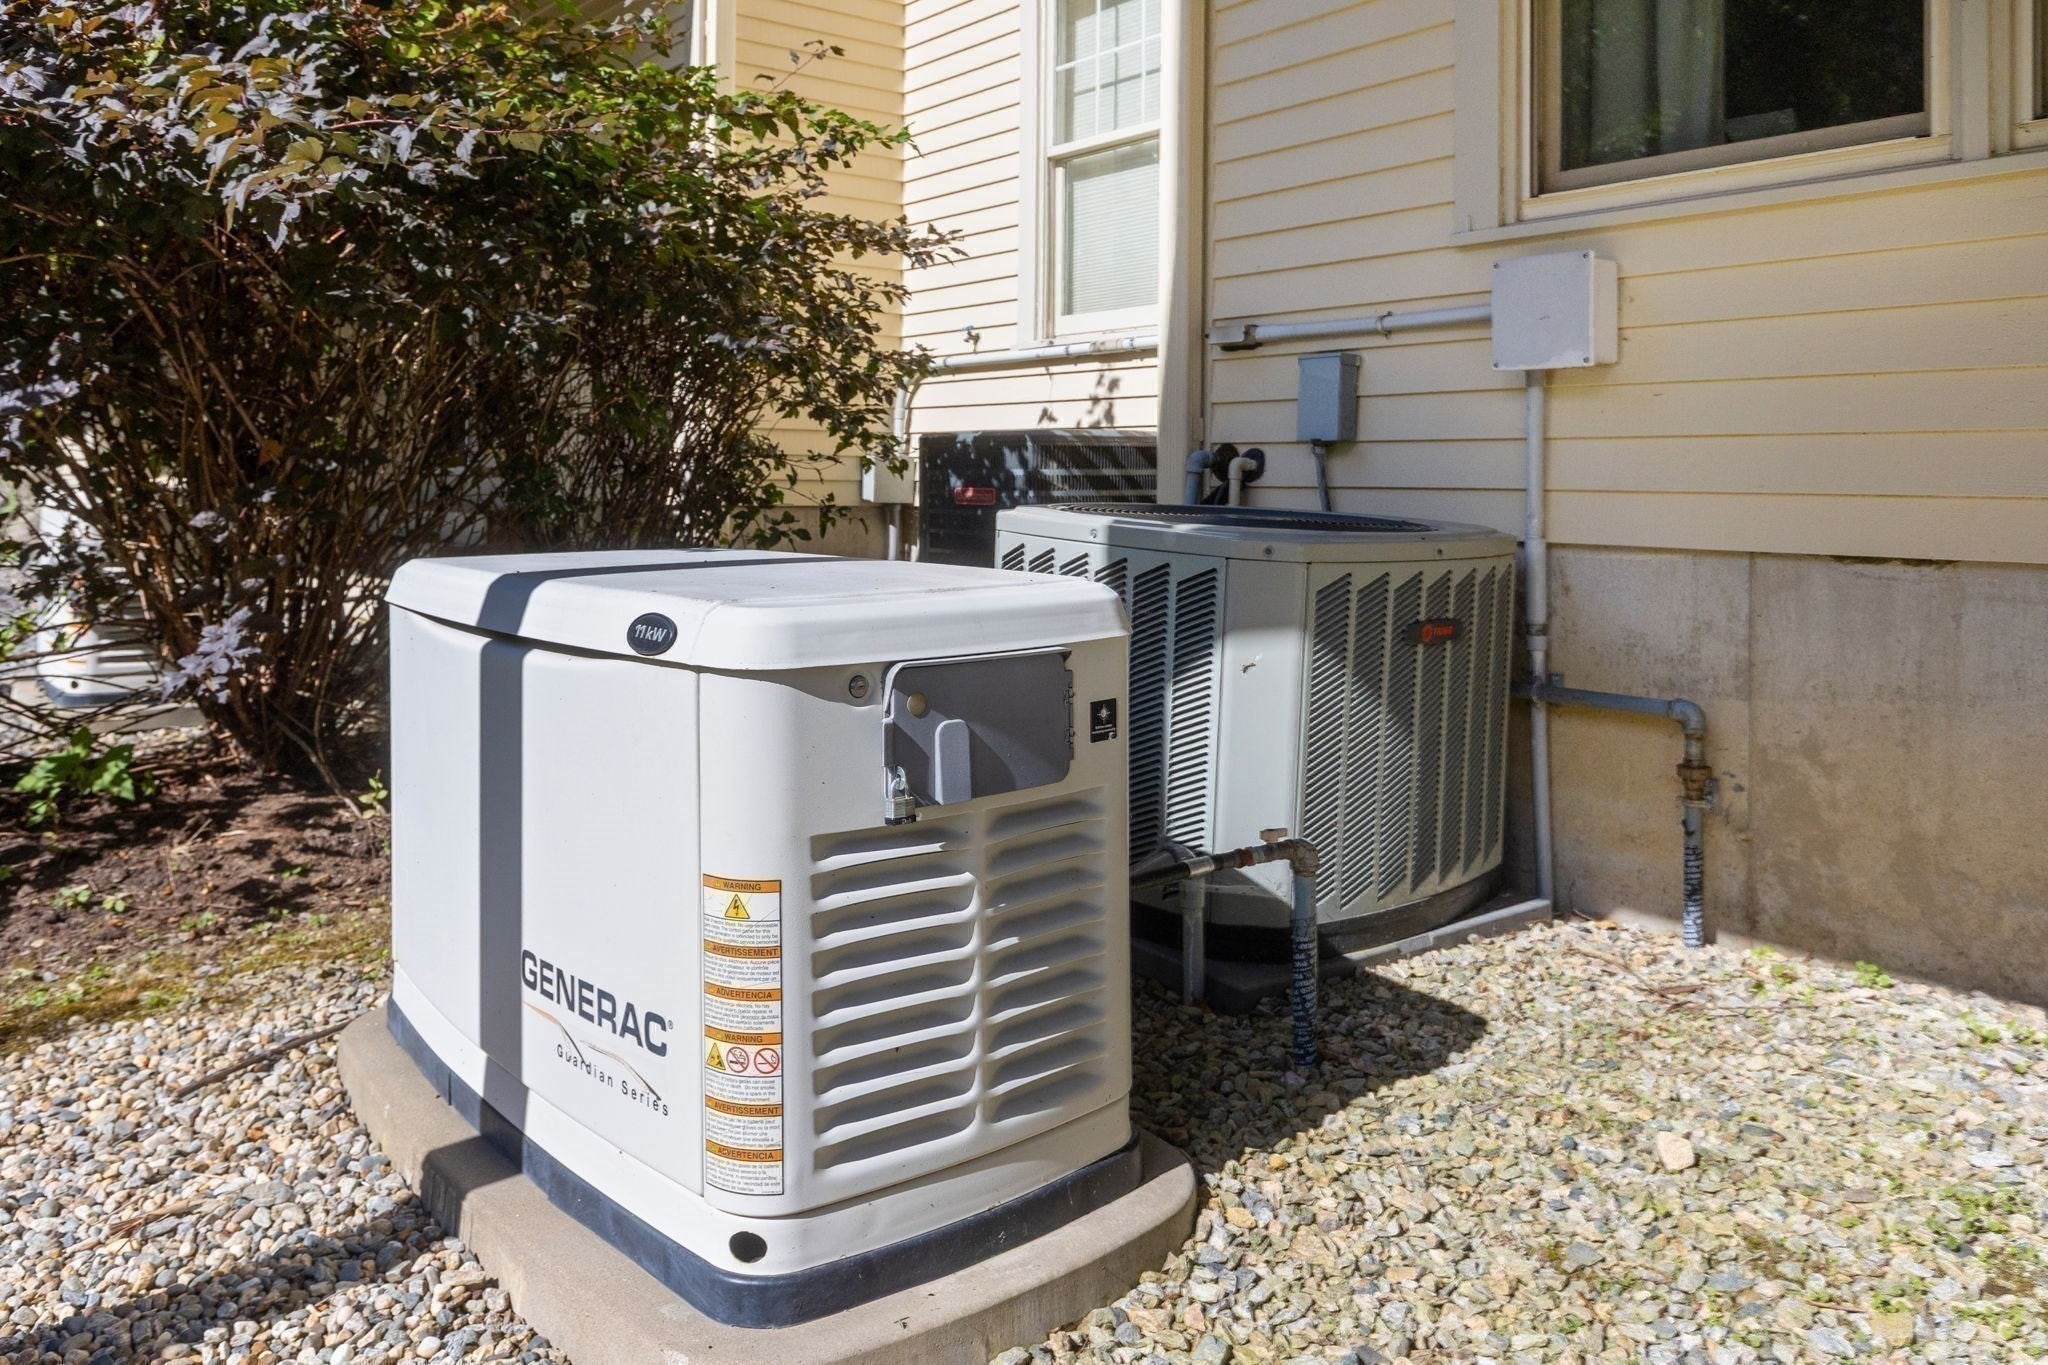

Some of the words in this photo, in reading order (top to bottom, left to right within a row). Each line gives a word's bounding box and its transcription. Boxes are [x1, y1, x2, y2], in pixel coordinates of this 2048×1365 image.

[635, 624, 667, 642] 11kW
[722, 880, 762, 891] WARNING
[712, 944, 778, 956] AVERTISSEMENT
[716, 987, 773, 999] ADVERTENCIA
[724, 1033, 763, 1043] WARNING
[556, 1043, 613, 1088] Guardian
[621, 1080, 669, 1116] Series
[714, 1101, 779, 1115] AVERTISSEMENT
[717, 1147, 774, 1160] ADVERTENCIA
